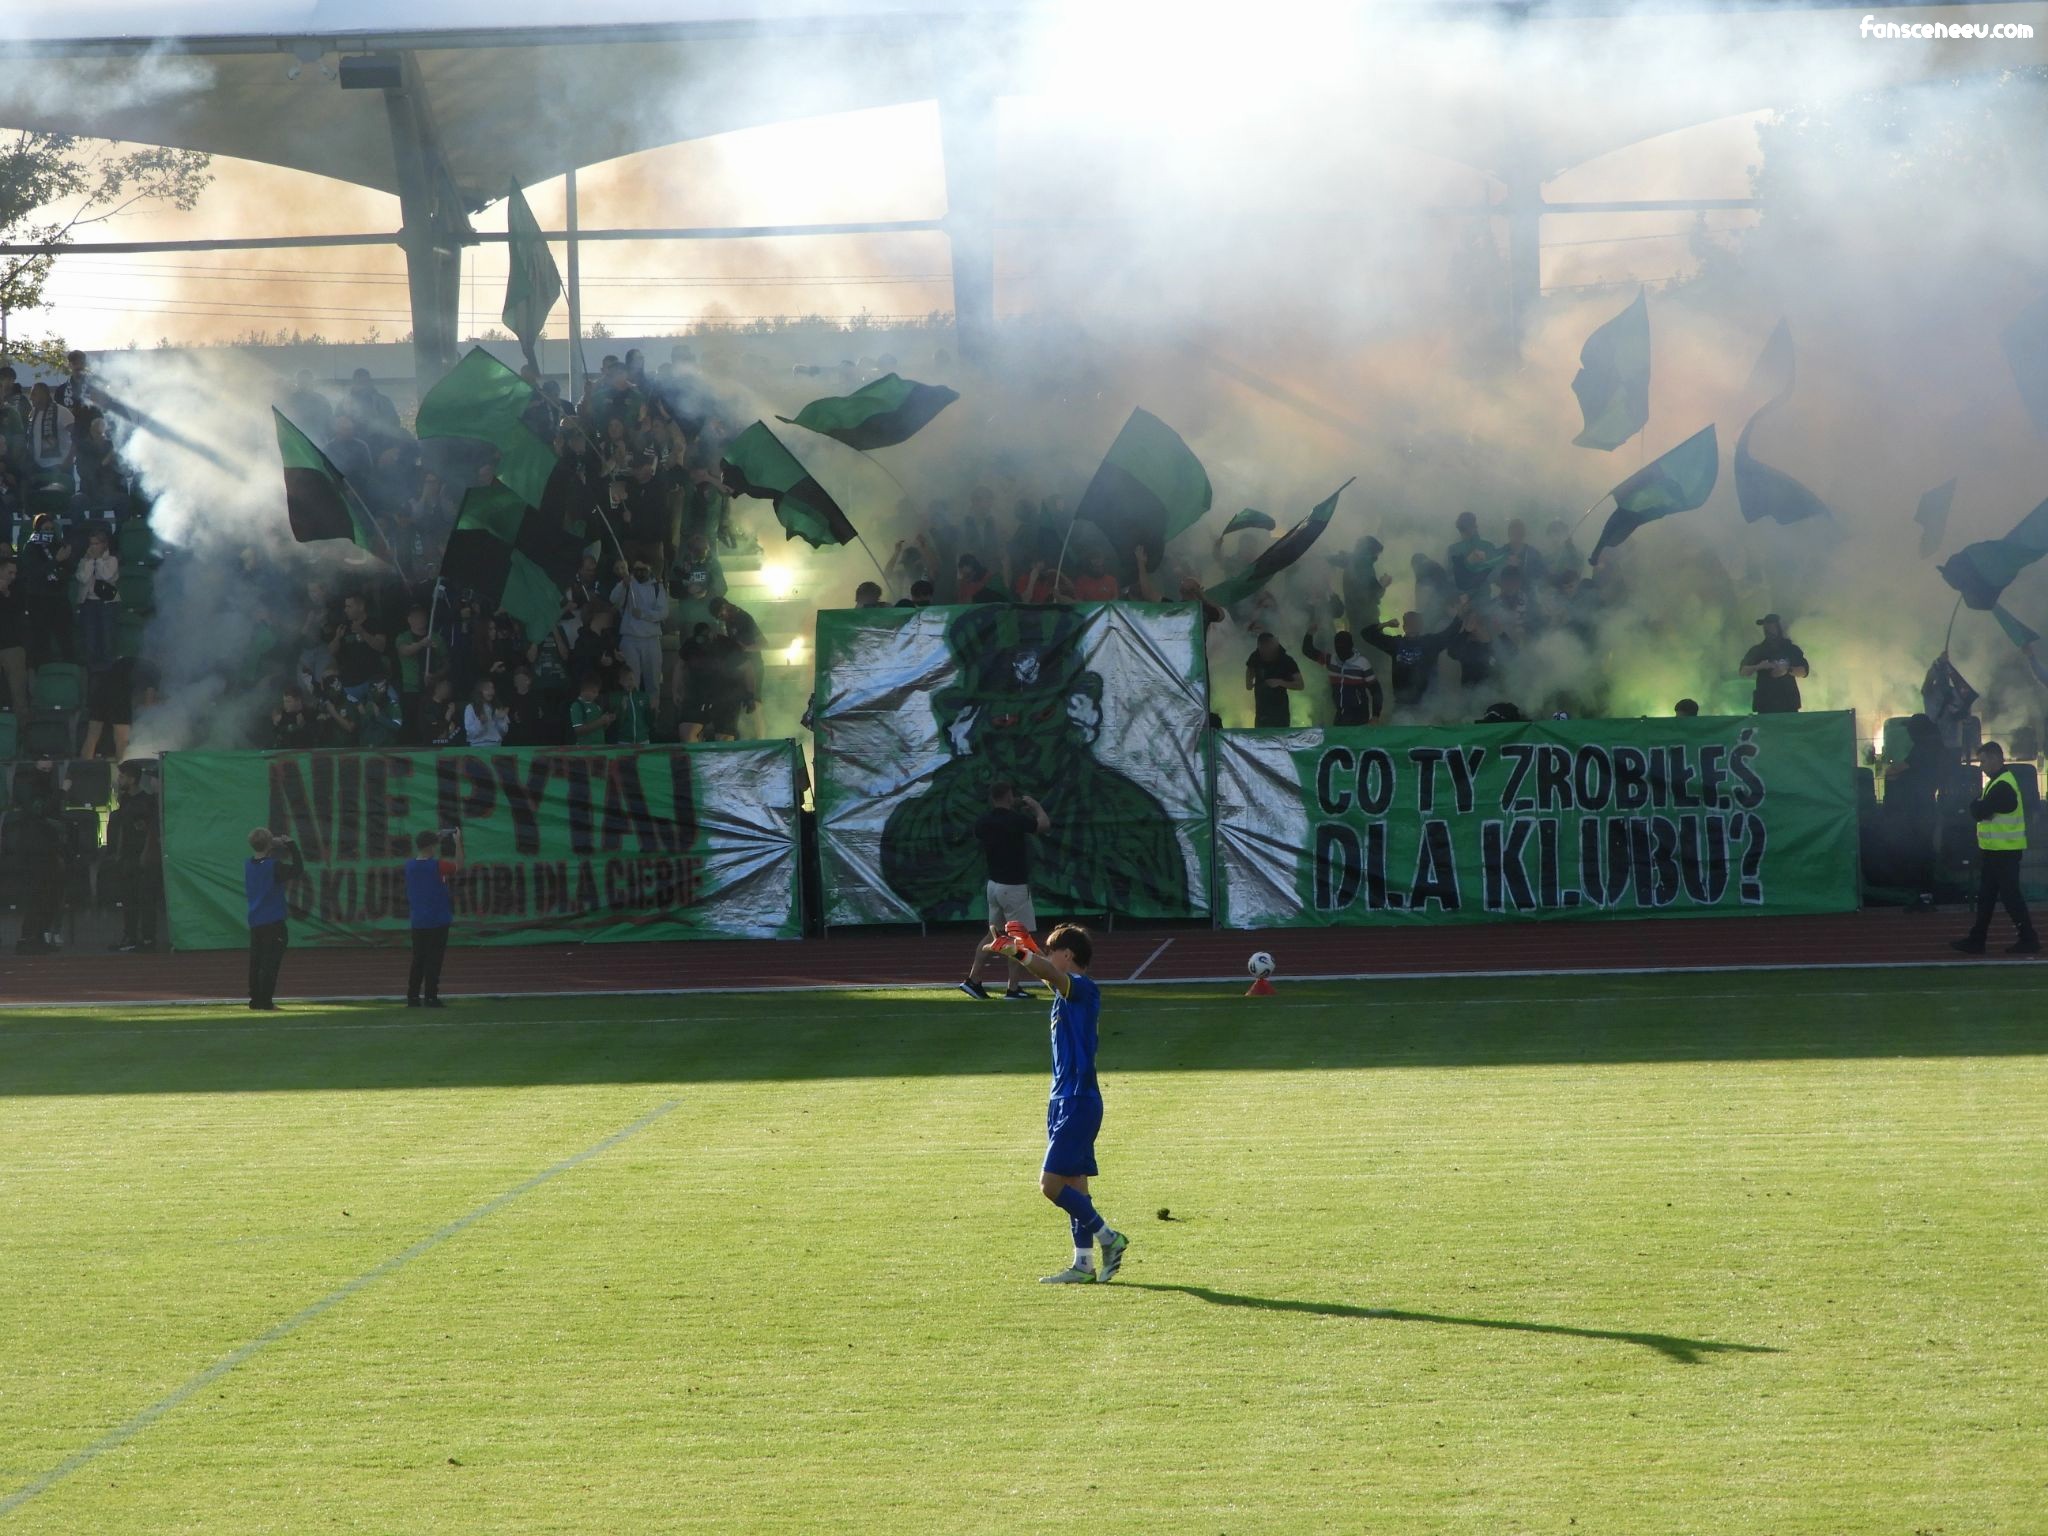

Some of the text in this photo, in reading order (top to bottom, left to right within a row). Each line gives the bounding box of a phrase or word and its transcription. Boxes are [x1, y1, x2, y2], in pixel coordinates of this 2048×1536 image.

[268, 752, 700, 863] NIE PYTAJ
[1316, 727, 1767, 818] CO TY ZROBIŁEŚ
[447, 862, 527, 917] ROBI
[533, 858, 600, 914] DLA
[605, 855, 706, 911] CIEBIE
[1312, 811, 1767, 914] DLA KLUBU?
